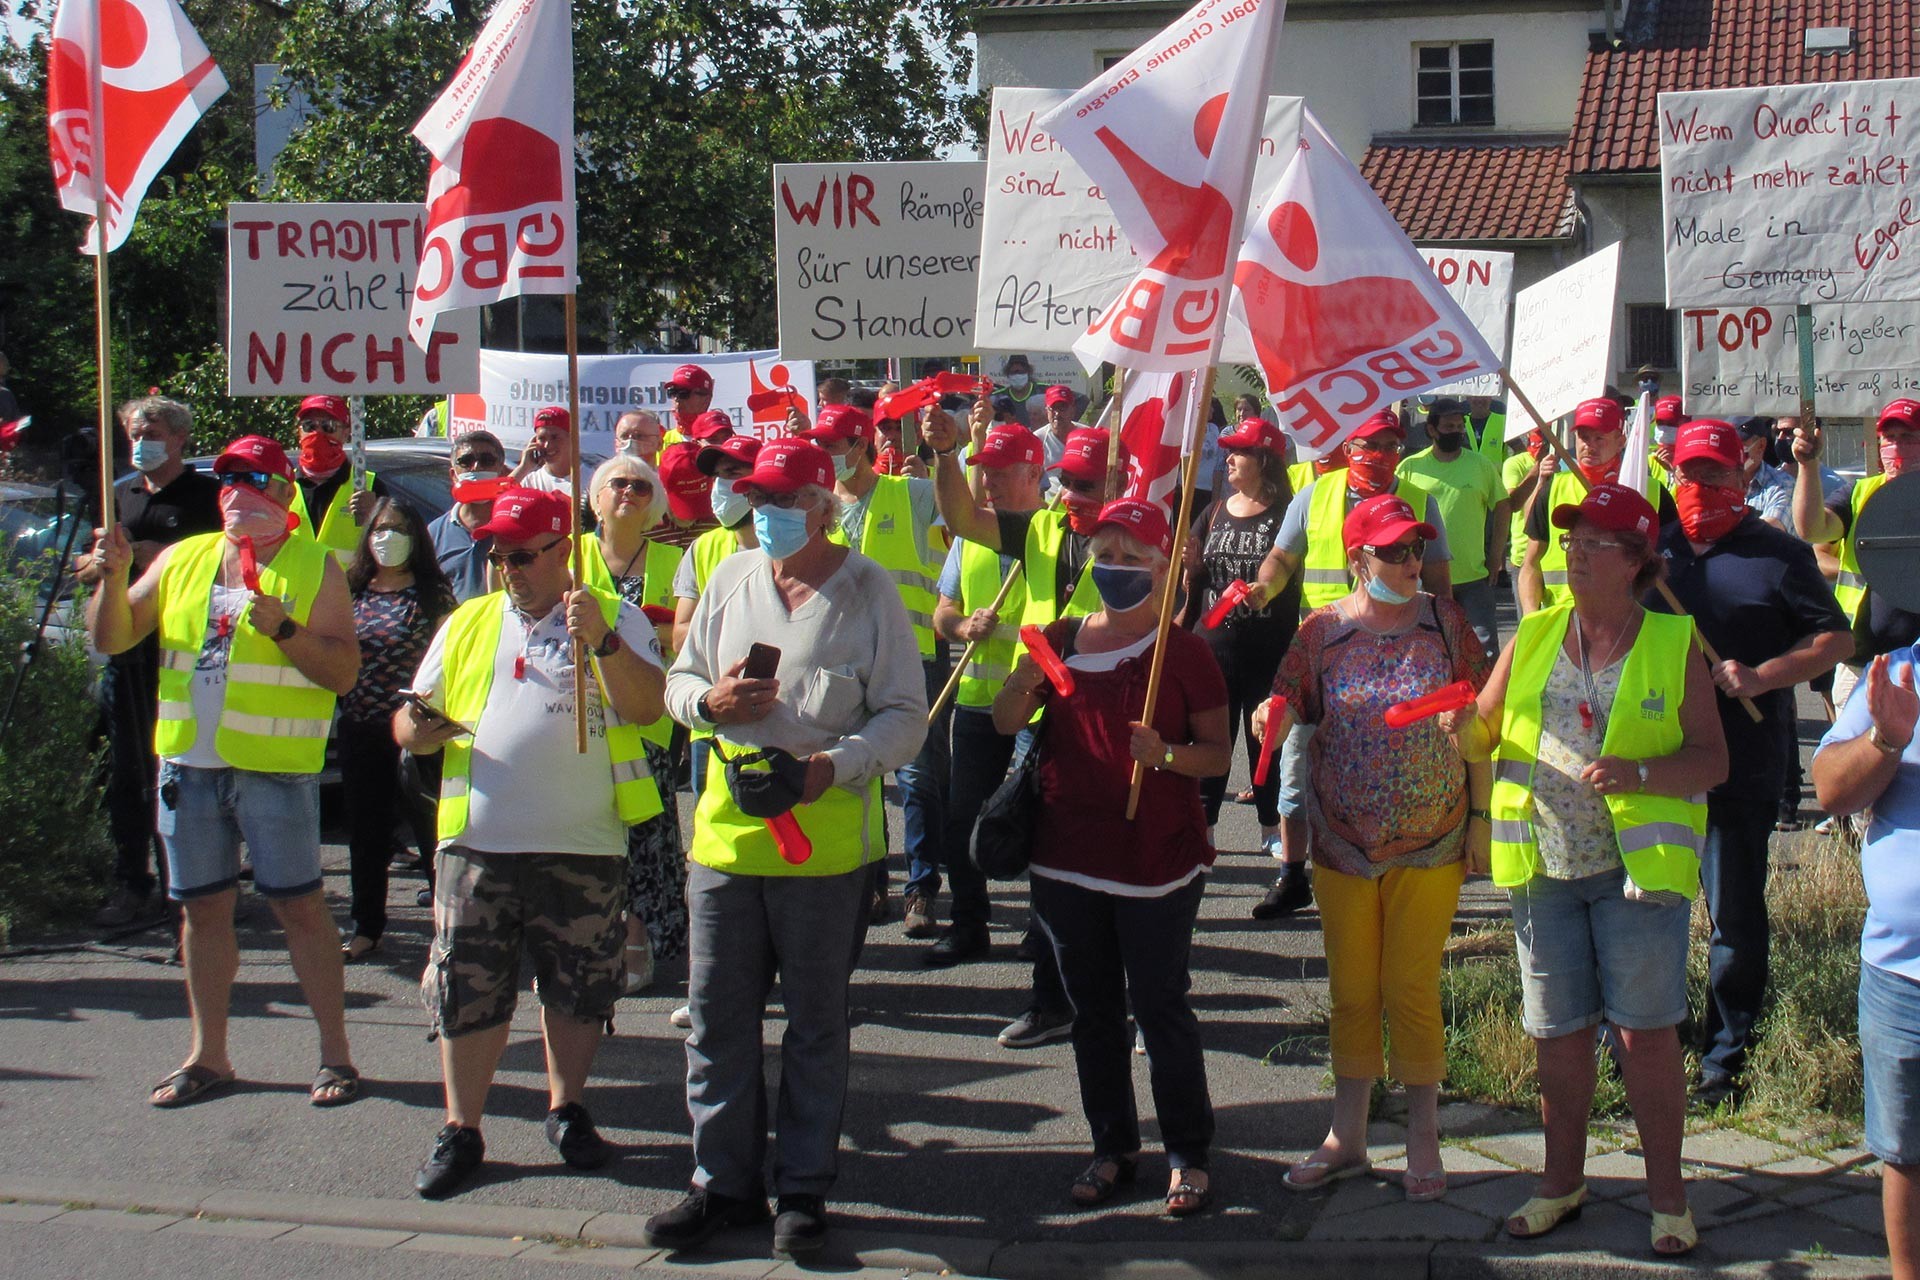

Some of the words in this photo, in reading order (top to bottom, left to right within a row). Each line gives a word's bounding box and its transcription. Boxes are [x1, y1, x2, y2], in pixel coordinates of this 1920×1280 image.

[1665, 107, 1734, 144] Wenn
[1753, 100, 1902, 140] Qualität
[1000, 170, 1066, 197] sind
[1671, 164, 1735, 194] nicht
[1752, 160, 1815, 189] mehr
[1827, 155, 1910, 186] zählt
[781, 171, 881, 230] WIR
[1059, 225, 1118, 253] nicht
[1674, 217, 1745, 247] Made
[1766, 216, 1808, 239] in
[798, 247, 851, 289] für
[1722, 261, 1838, 299] Germany
[1684, 306, 1773, 352] TOP
[1782, 314, 1916, 355] Abeitgeber
[247, 331, 460, 385] NICHT
[1689, 376, 1741, 397] seine
[1754, 369, 1849, 398] Mitareiter
[1857, 372, 1881, 396] auf
